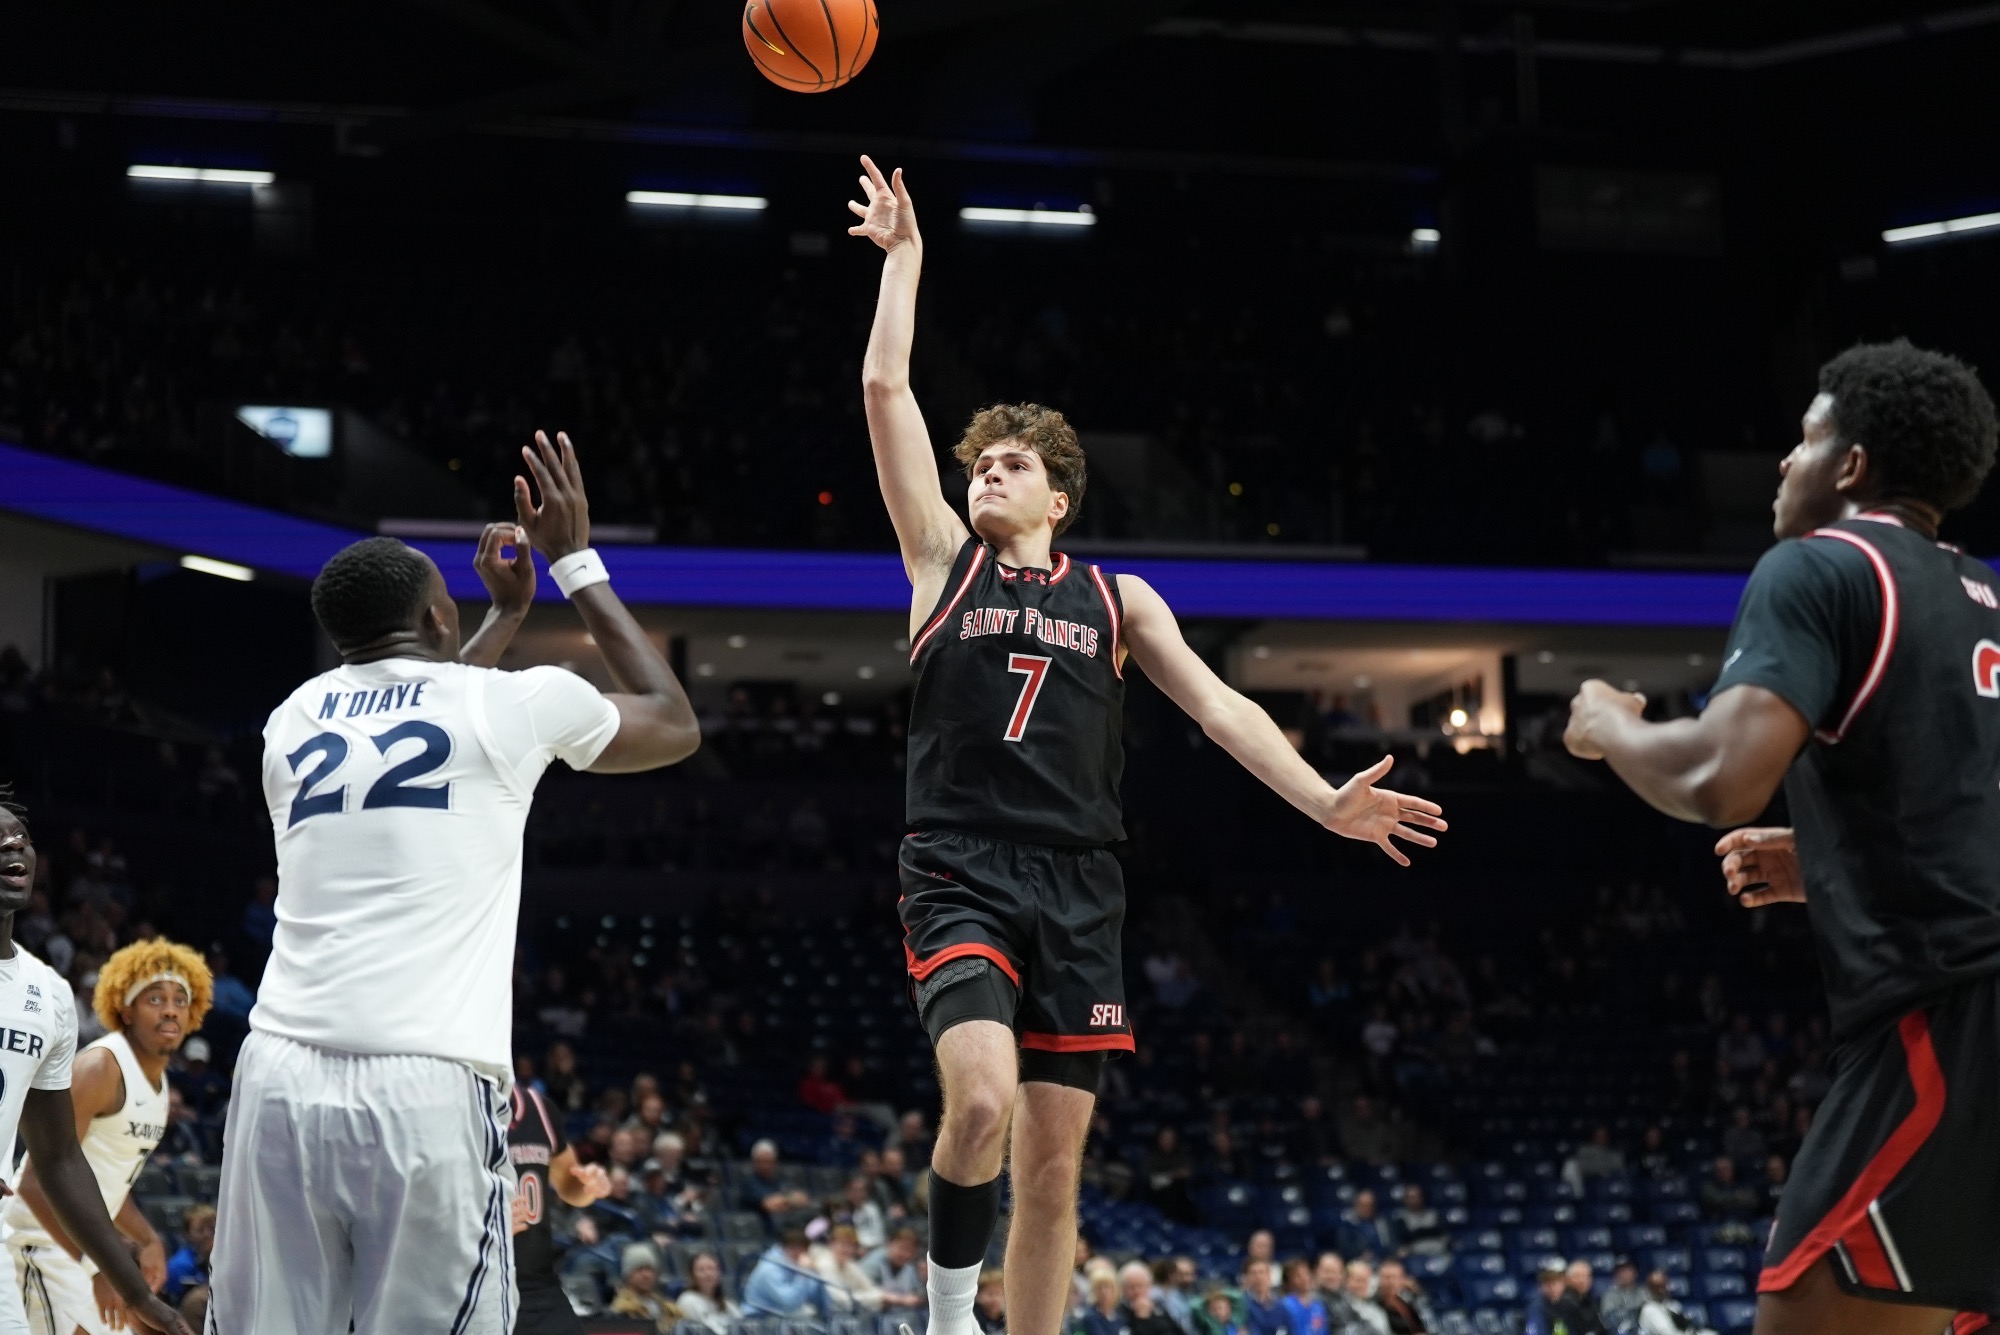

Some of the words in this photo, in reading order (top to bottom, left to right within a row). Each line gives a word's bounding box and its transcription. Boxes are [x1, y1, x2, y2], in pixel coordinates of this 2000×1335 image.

[959, 607, 1020, 641] SAINT
[1024, 606, 1099, 659] FRANCIS
[317, 680, 429, 720] N'DIAYE
[1002, 652, 1053, 743] 7
[285, 719, 455, 831] 22
[1089, 1003, 1123, 1027] SFU
